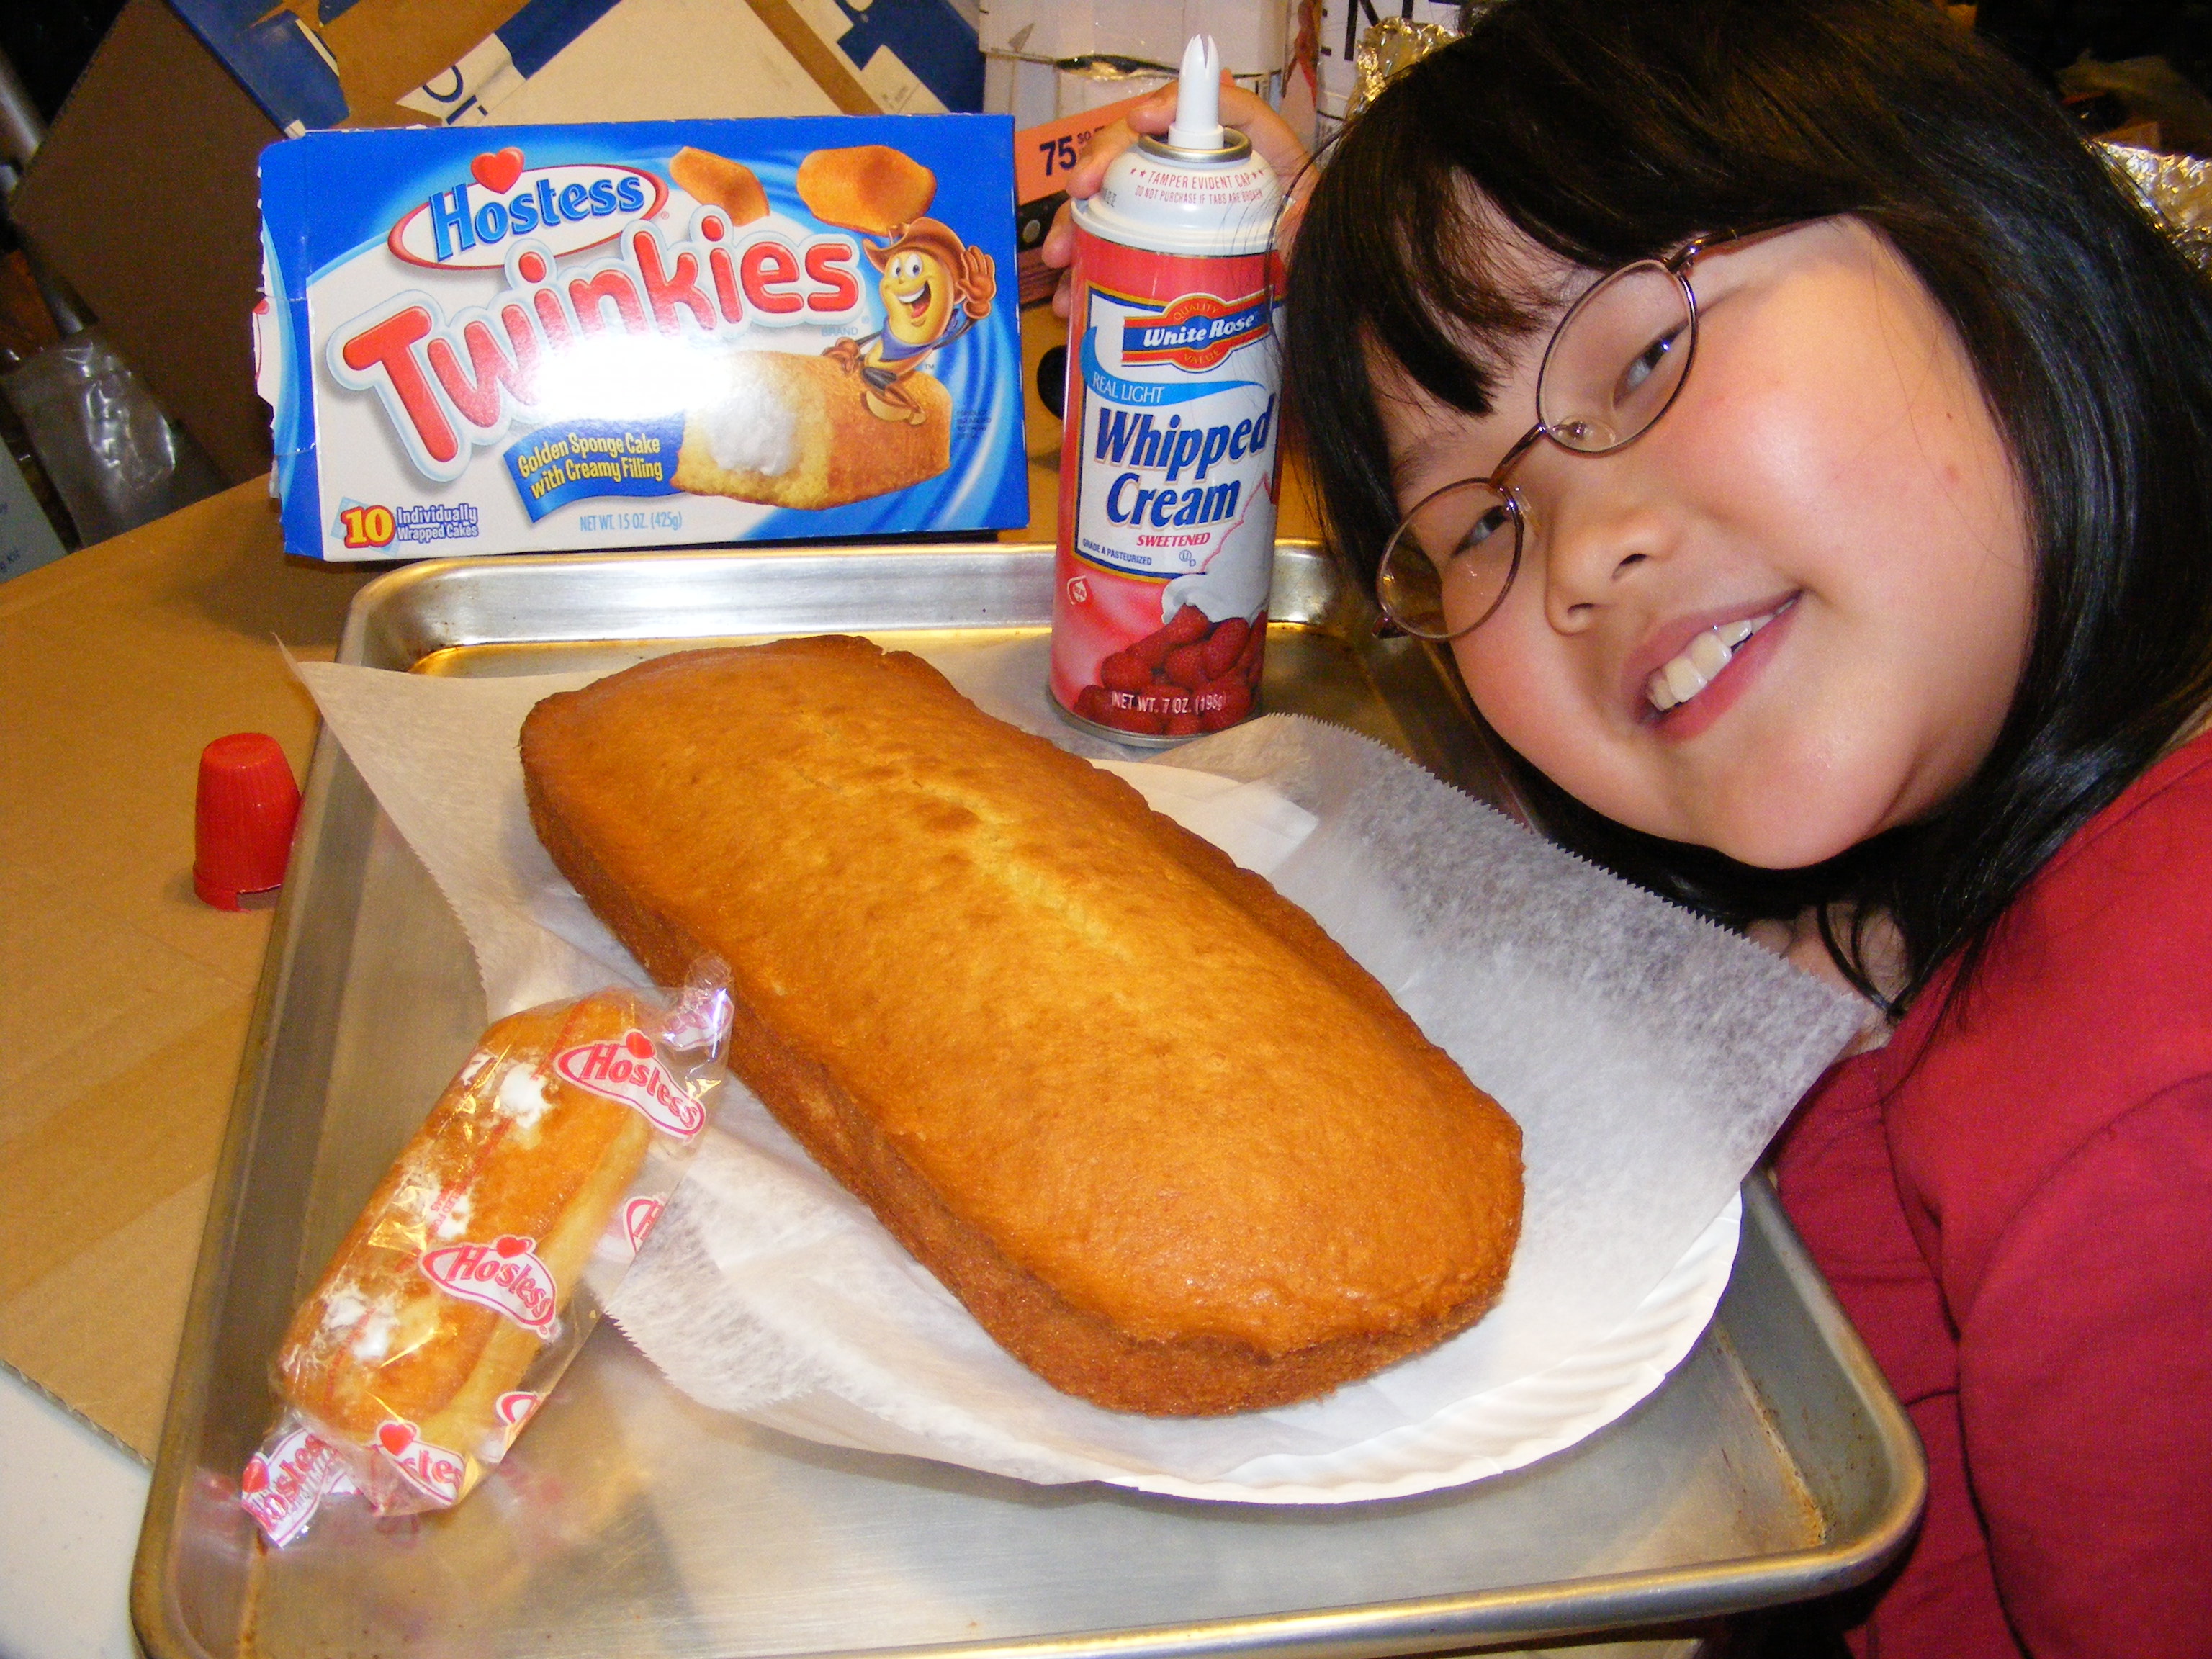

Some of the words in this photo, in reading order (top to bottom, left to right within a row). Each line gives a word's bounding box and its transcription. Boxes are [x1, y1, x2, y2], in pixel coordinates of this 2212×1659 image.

[1039, 135, 1077, 176] 75
[1145, 187, 1158, 200] NOT
[1160, 190, 1197, 204] PURCHASE
[1200, 194, 1205, 204] IF
[1210, 192, 1227, 204] TABS
[1147, 171, 1187, 189] TAMPER
[1192, 176, 1232, 190] EVIDENT
[1234, 172, 1251, 188] CAP
[429, 176, 645, 262] Hostess
[1173, 303, 1219, 321] QUALITY
[342, 215, 860, 463] Twinkies
[821, 326, 858, 337] BRAND
[1143, 326, 1207, 347] White
[1209, 315, 1254, 339] Rose
[1184, 349, 1221, 364] VALUE
[1092, 372, 1119, 397] REAL
[1121, 384, 1165, 404] LIGHT
[1096, 393, 1276, 482] Whipped
[518, 440, 569, 478] Golden
[567, 432, 624, 458] Sponge
[625, 432, 660, 454] Cake
[530, 464, 565, 499] with
[565, 459, 621, 482] Creamy
[621, 457, 662, 482] Filling
[1107, 472, 1242, 528] Cream
[342, 505, 396, 548] 10
[396, 503, 478, 525] Individually
[397, 526, 444, 544] Wrapped
[446, 521, 479, 538] Cakes
[579, 515, 597, 531] NET
[598, 513, 614, 530] WT.
[618, 513, 630, 529] 15
[650, 511, 683, 531] (425g)
[1082, 538, 1100, 554] GRADE
[1107, 548, 1152, 565] PASTEURIZED
[1136, 532, 1211, 548] SWEETENED
[1112, 690, 1134, 710] NET
[1137, 696, 1159, 713] WT.
[1162, 698, 1171, 714] 7
[1172, 697, 1192, 714] OZ.
[580, 1042, 700, 1129] Hostess
[445, 1243, 552, 1316] Hostess
